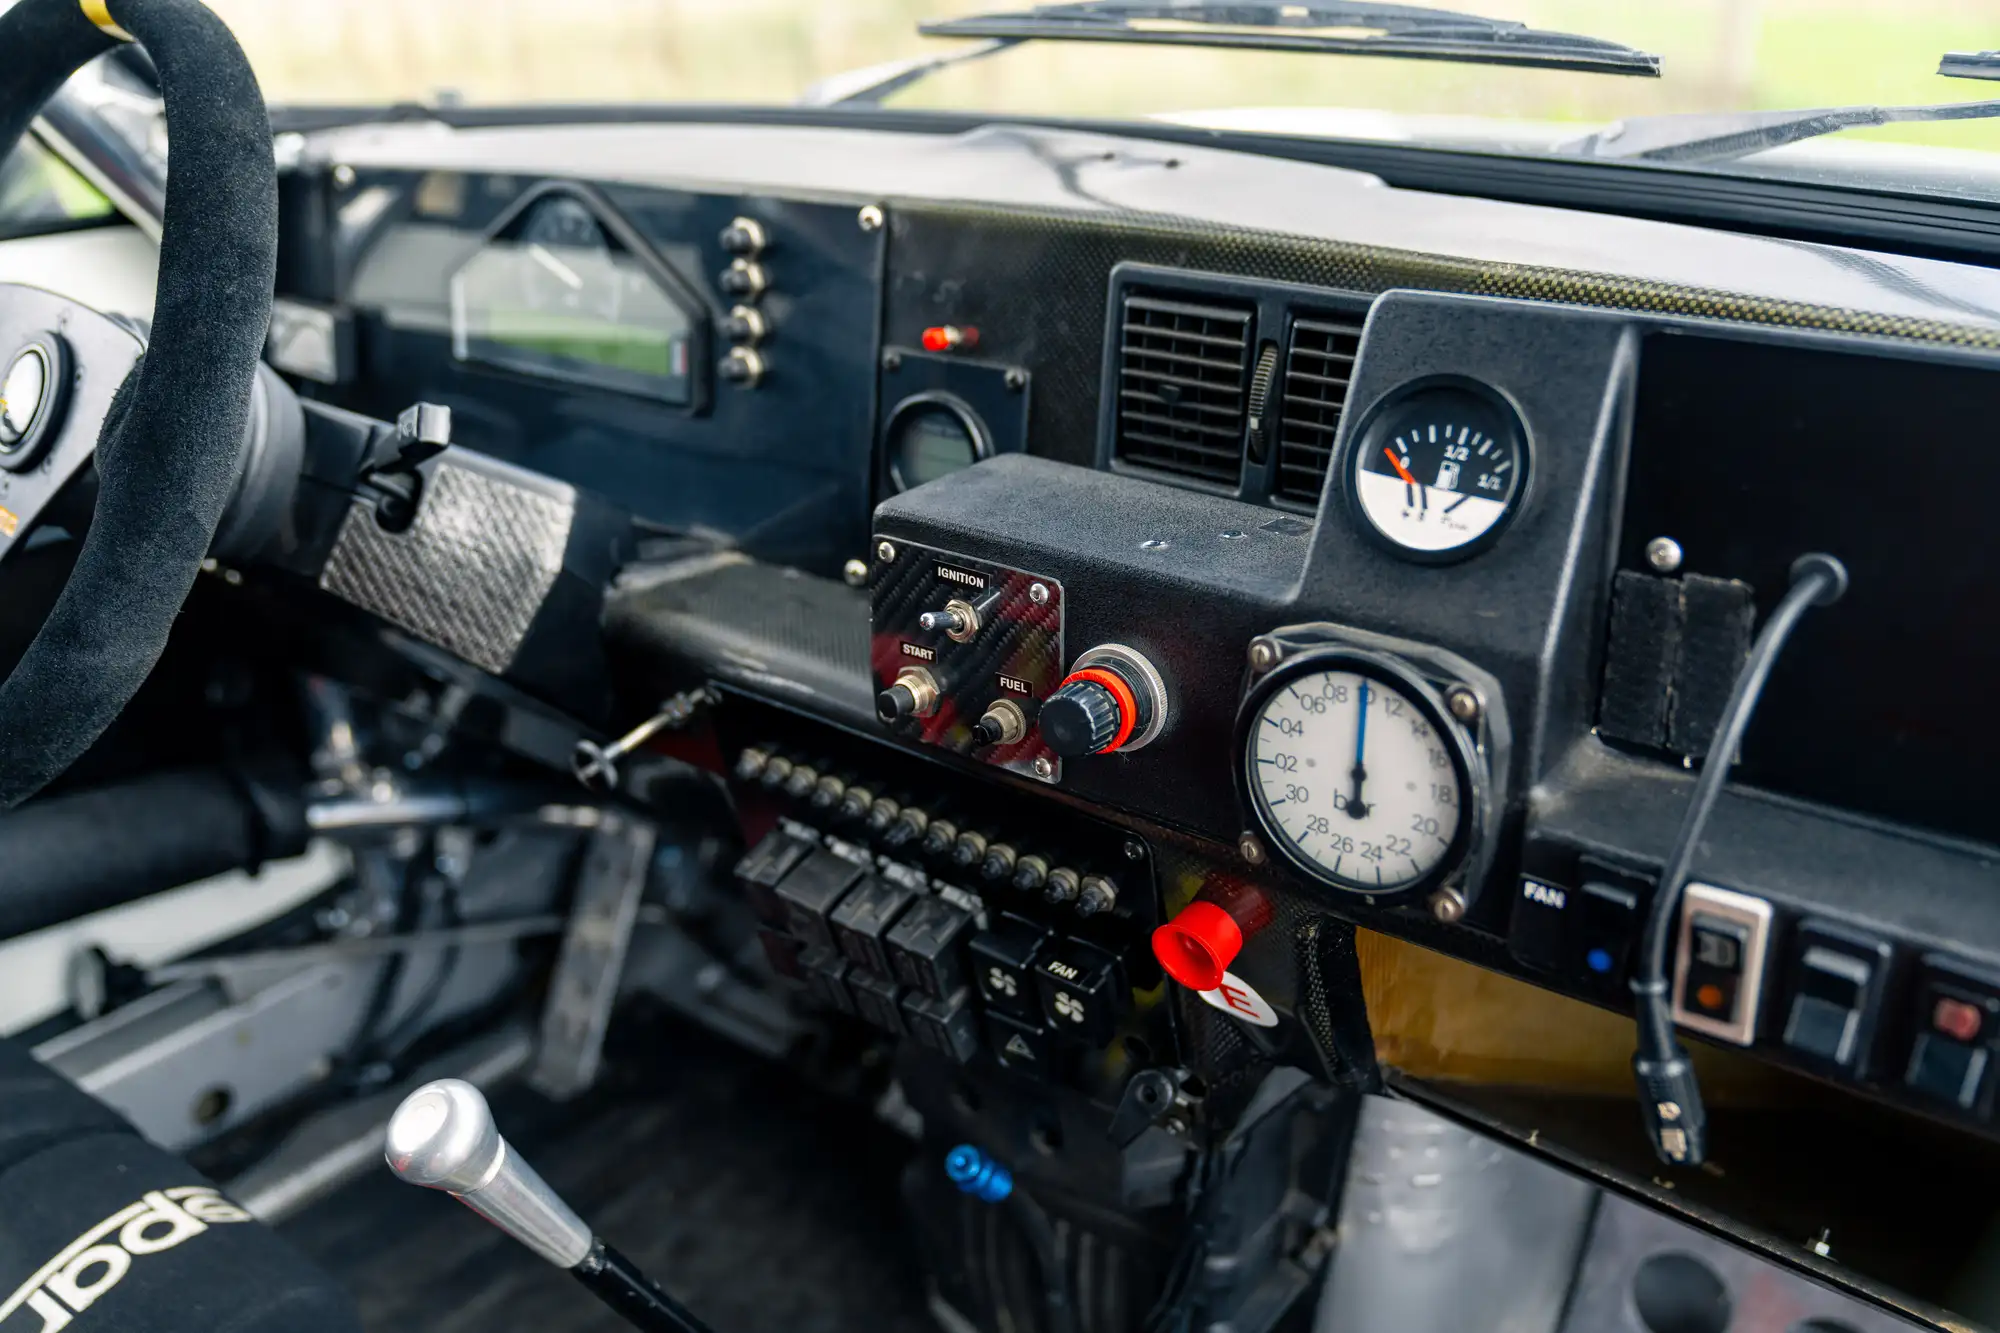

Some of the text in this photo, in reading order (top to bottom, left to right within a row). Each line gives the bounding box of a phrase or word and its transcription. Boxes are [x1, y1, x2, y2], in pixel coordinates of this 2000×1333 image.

[1444, 444, 1469, 461] 1/2
[937, 566, 984, 589] IGNITION
[903, 643, 934, 660] START
[1000, 677, 1028, 693] FUEL
[1333, 788, 1376, 817] br
[1524, 880, 1565, 909] FAN
[1047, 961, 1078, 980] FAN
[1219, 983, 1260, 1020] E
